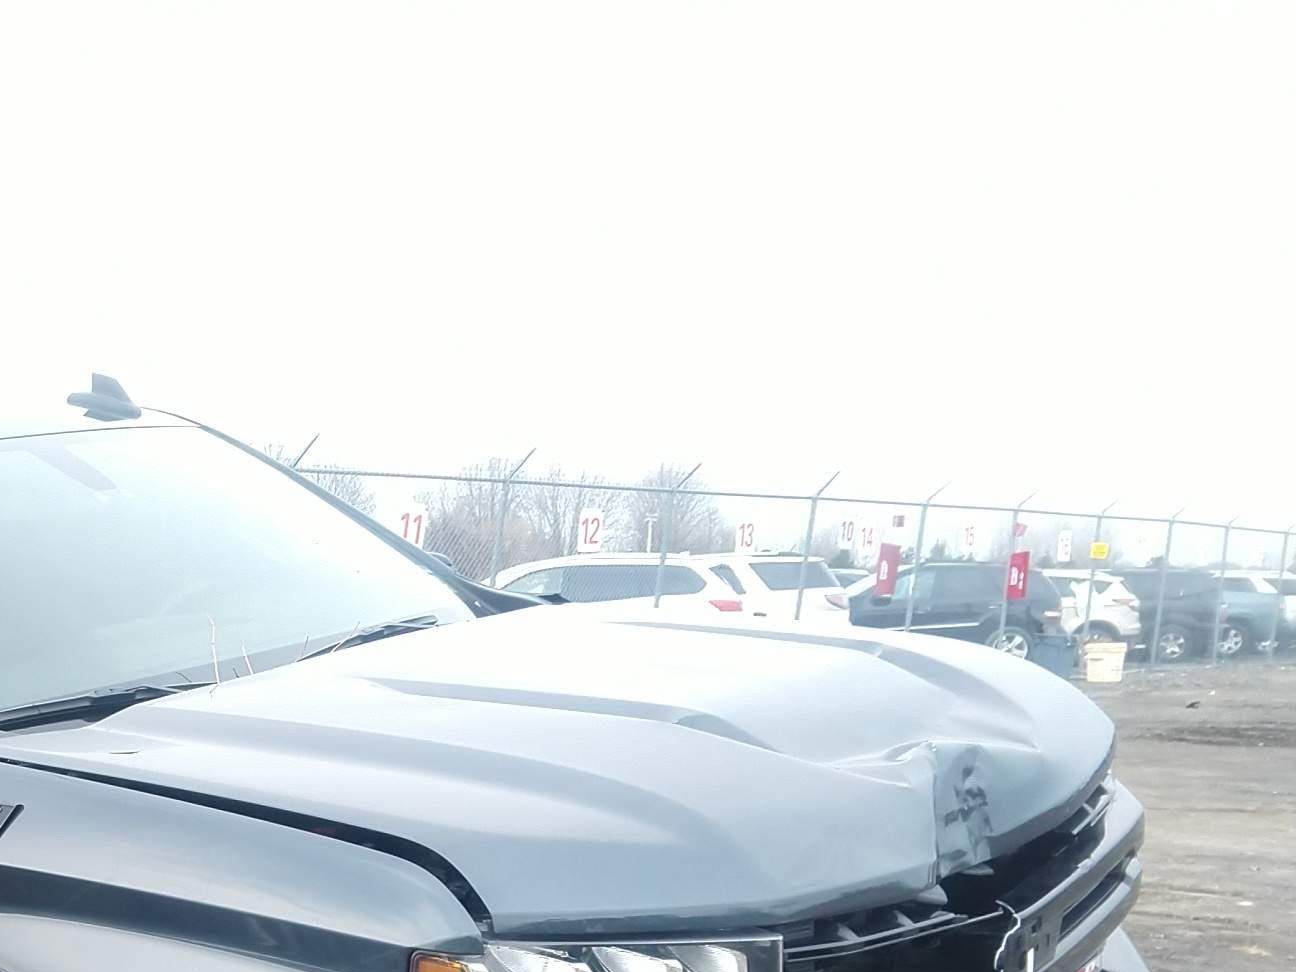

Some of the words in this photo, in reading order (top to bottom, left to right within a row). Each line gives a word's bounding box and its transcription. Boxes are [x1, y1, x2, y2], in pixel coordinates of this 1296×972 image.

[401, 512, 422, 545] 11
[582, 517, 600, 545] 12
[739, 523, 754, 548] 13
[841, 520, 854, 542] 10
[861, 527, 873, 548] 14
